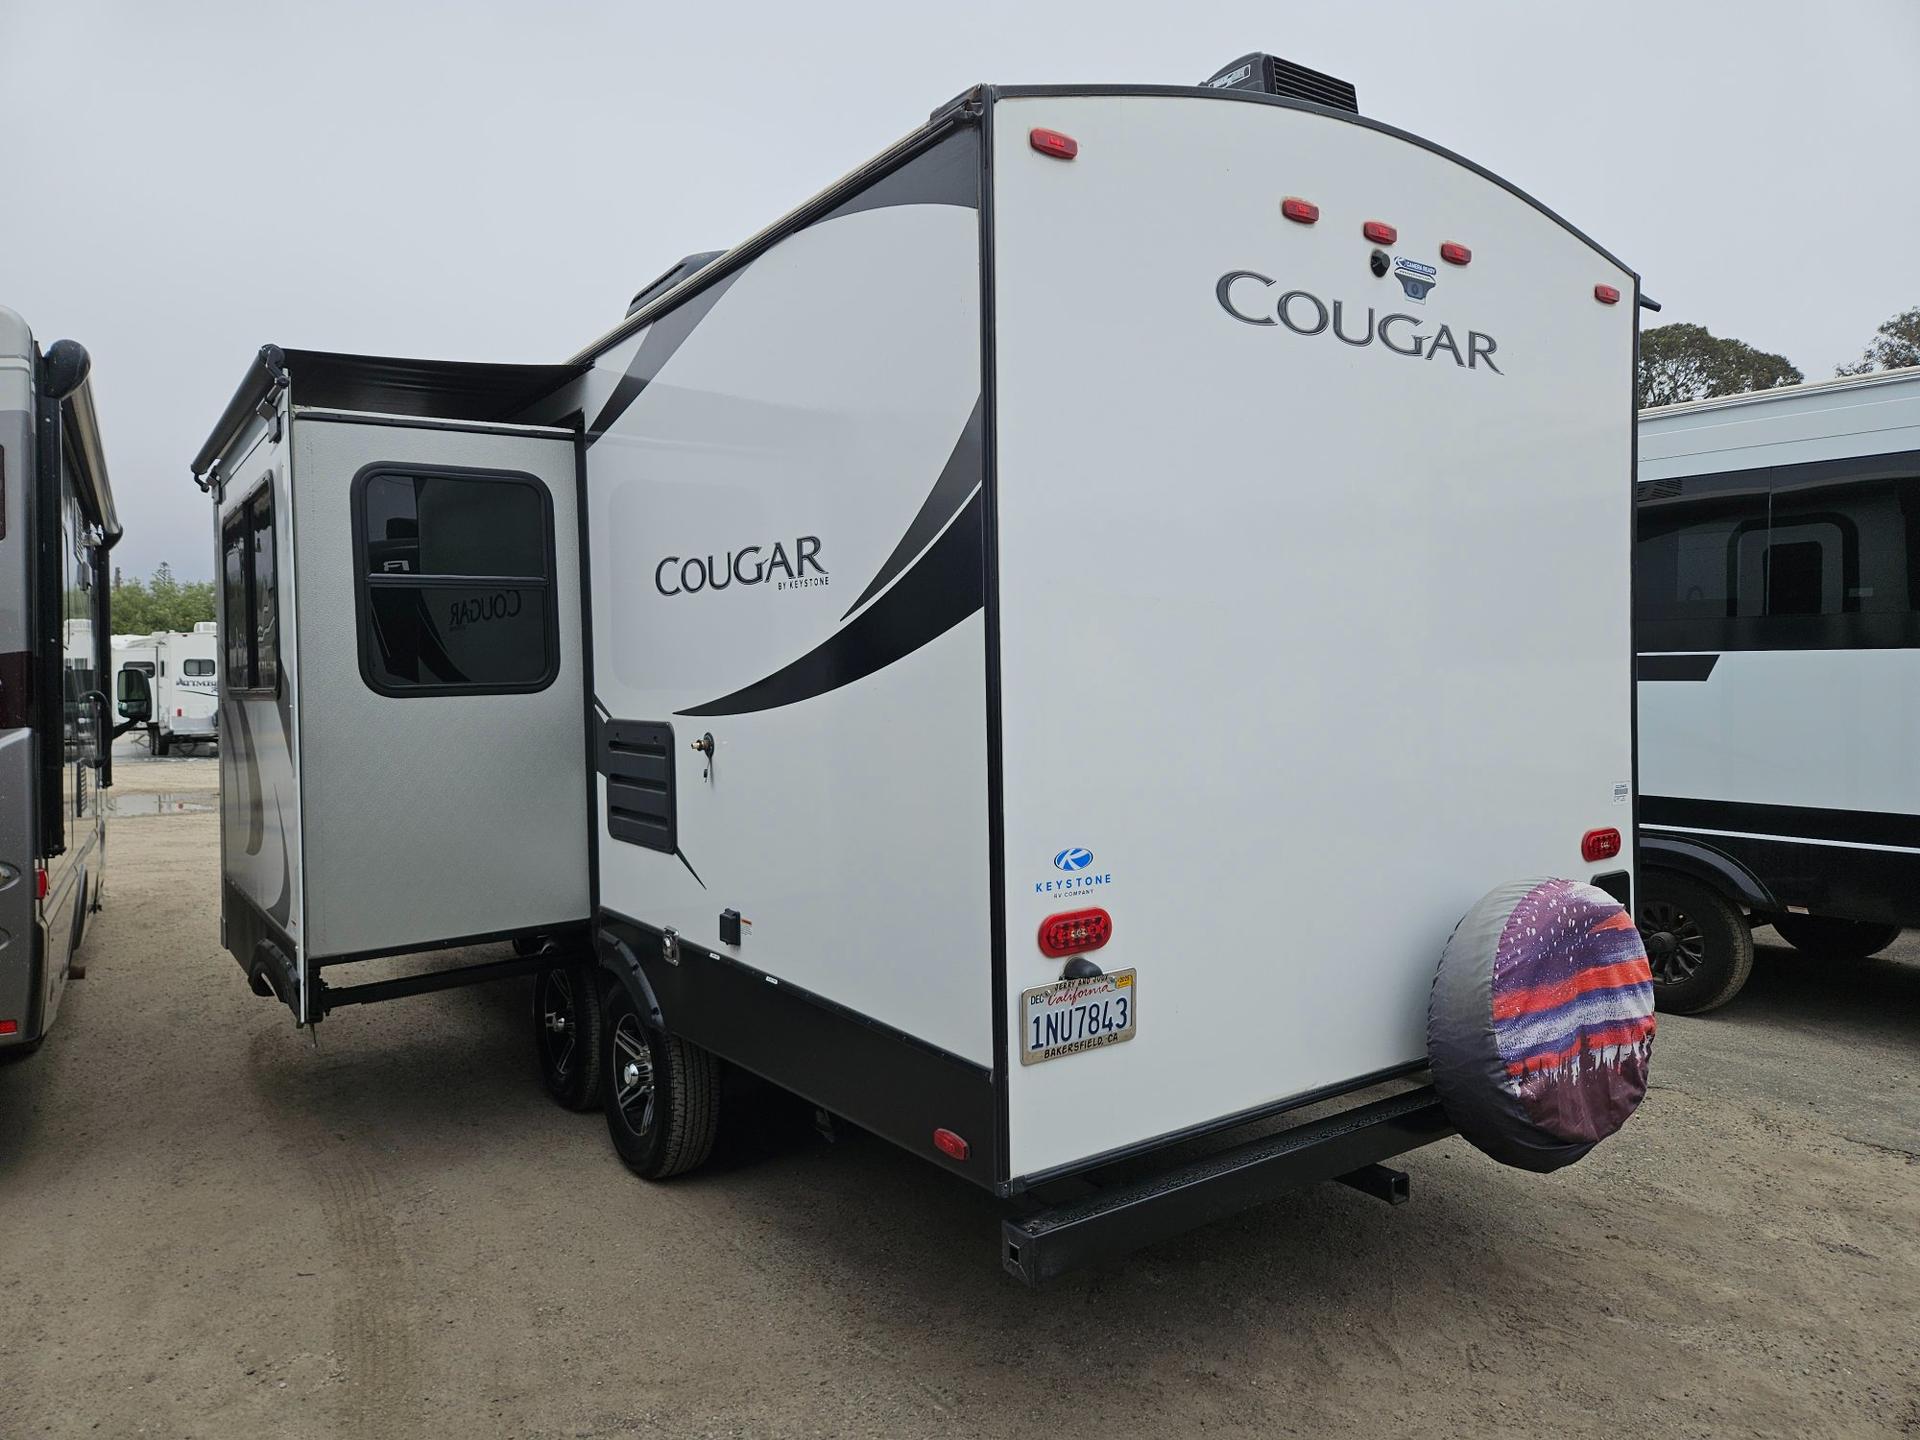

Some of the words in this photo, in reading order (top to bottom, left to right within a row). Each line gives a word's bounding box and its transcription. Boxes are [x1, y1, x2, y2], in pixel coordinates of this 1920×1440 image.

[1215, 269, 1505, 376] COUGAR
[655, 535, 830, 597] COUGAR
[778, 582, 787, 591] BY
[789, 576, 830, 590] KEYSTONE
[1035, 874, 1112, 893] KEYSTONE
[1064, 889, 1094, 898] COMPANY
[1030, 994, 1045, 1005] DEC
[1047, 983, 1116, 1006] California
[1031, 997, 1128, 1050] 1NU7843
[1107, 1032, 1119, 1042] CA
